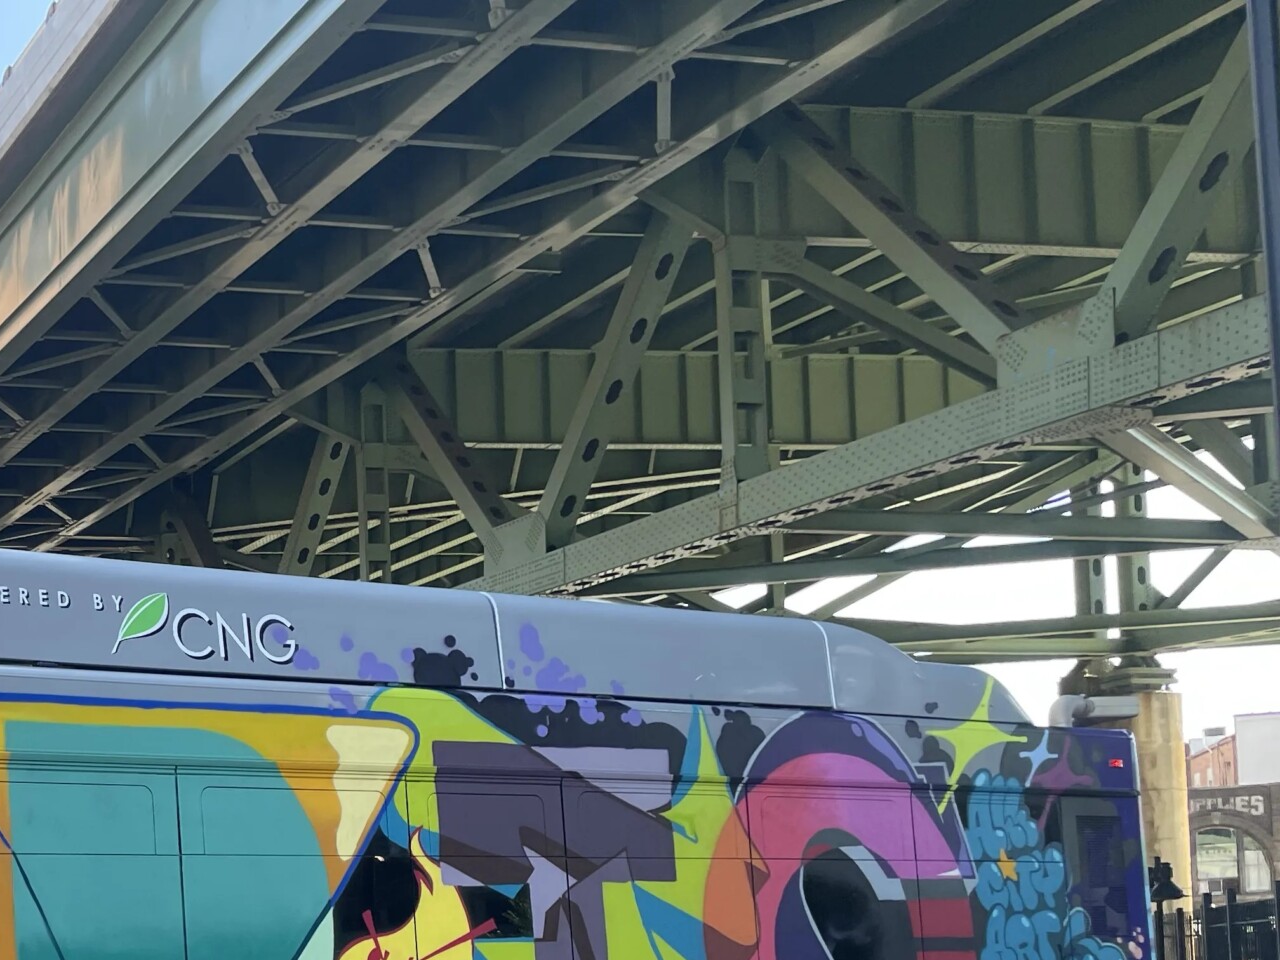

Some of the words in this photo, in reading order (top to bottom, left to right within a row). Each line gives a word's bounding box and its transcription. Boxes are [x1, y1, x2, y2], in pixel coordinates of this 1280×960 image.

[93, 593, 124, 612] BY
[172, 607, 299, 664] CNG
[1190, 795, 1265, 816] PPLIES
[975, 846, 1065, 912] CITY
